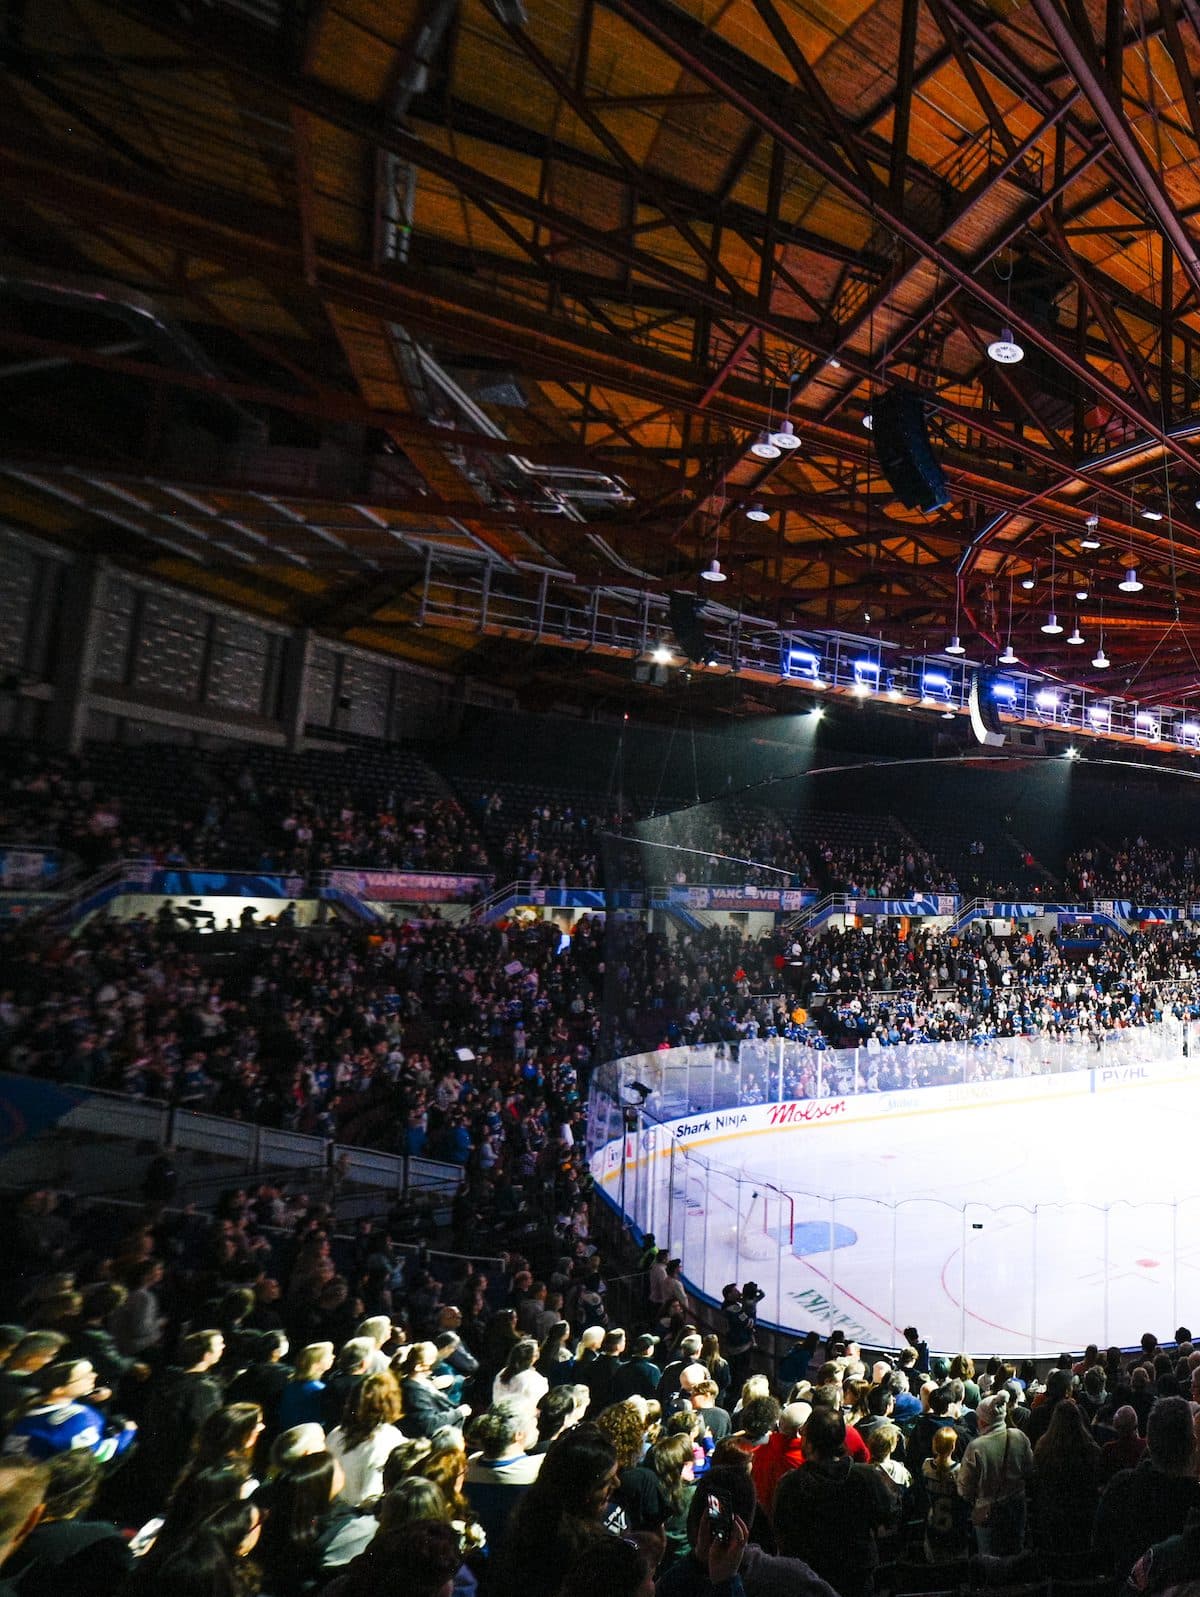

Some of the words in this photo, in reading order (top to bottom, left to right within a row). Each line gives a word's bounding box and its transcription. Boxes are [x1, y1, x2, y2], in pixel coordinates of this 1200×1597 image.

[365, 873, 457, 888] VANCUVER
[712, 888, 780, 900] VANCUVER
[767, 1100, 847, 1125] Molson
[676, 1120, 711, 1138] Shark
[716, 1113, 748, 1131] NINJA
